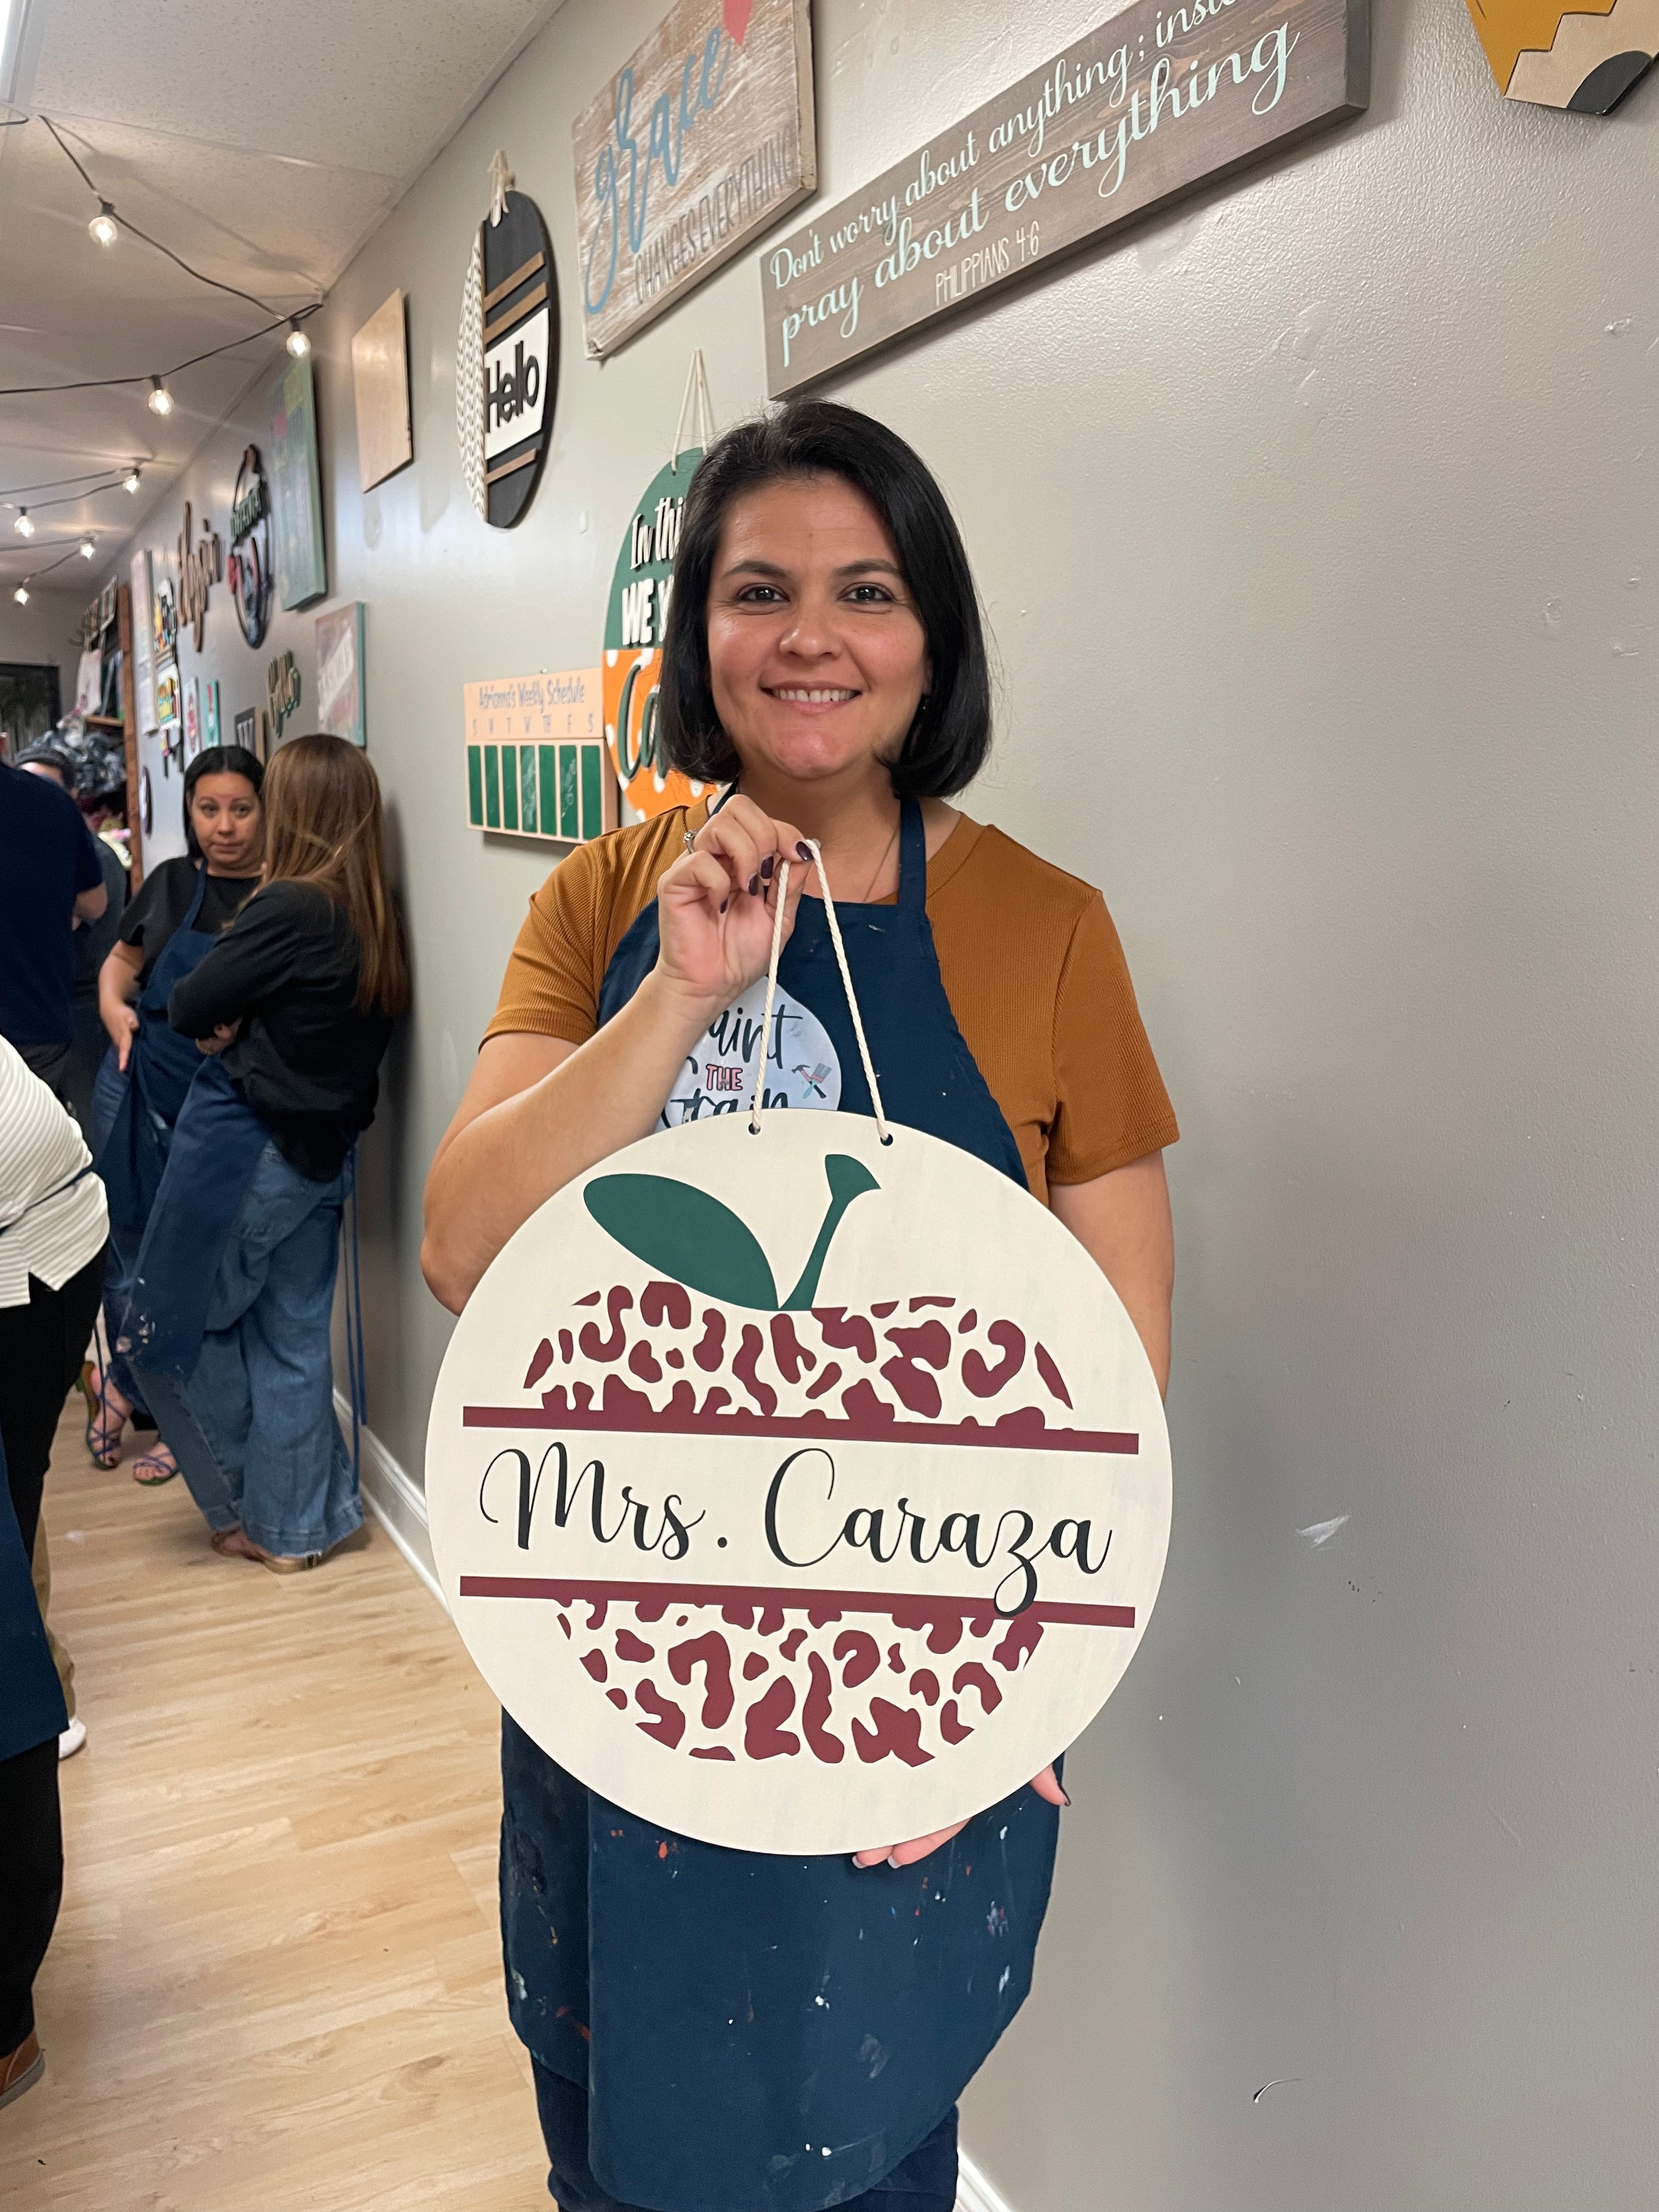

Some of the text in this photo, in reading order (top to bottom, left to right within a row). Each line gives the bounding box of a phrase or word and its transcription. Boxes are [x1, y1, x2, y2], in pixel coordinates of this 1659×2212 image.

[782, 21, 1300, 368] pray about everything
[830, 195, 900, 246] worry
[905, 131, 980, 207] about
[1017, 221, 1040, 262] 4:6
[630, 496, 684, 569] In thi
[622, 578, 654, 646] WE
[546, 676, 585, 706] Schedule
[709, 1004, 803, 1069] aint
[706, 1063, 743, 1091] THE
[480, 1442, 1112, 1617] Mrs. Caraza
